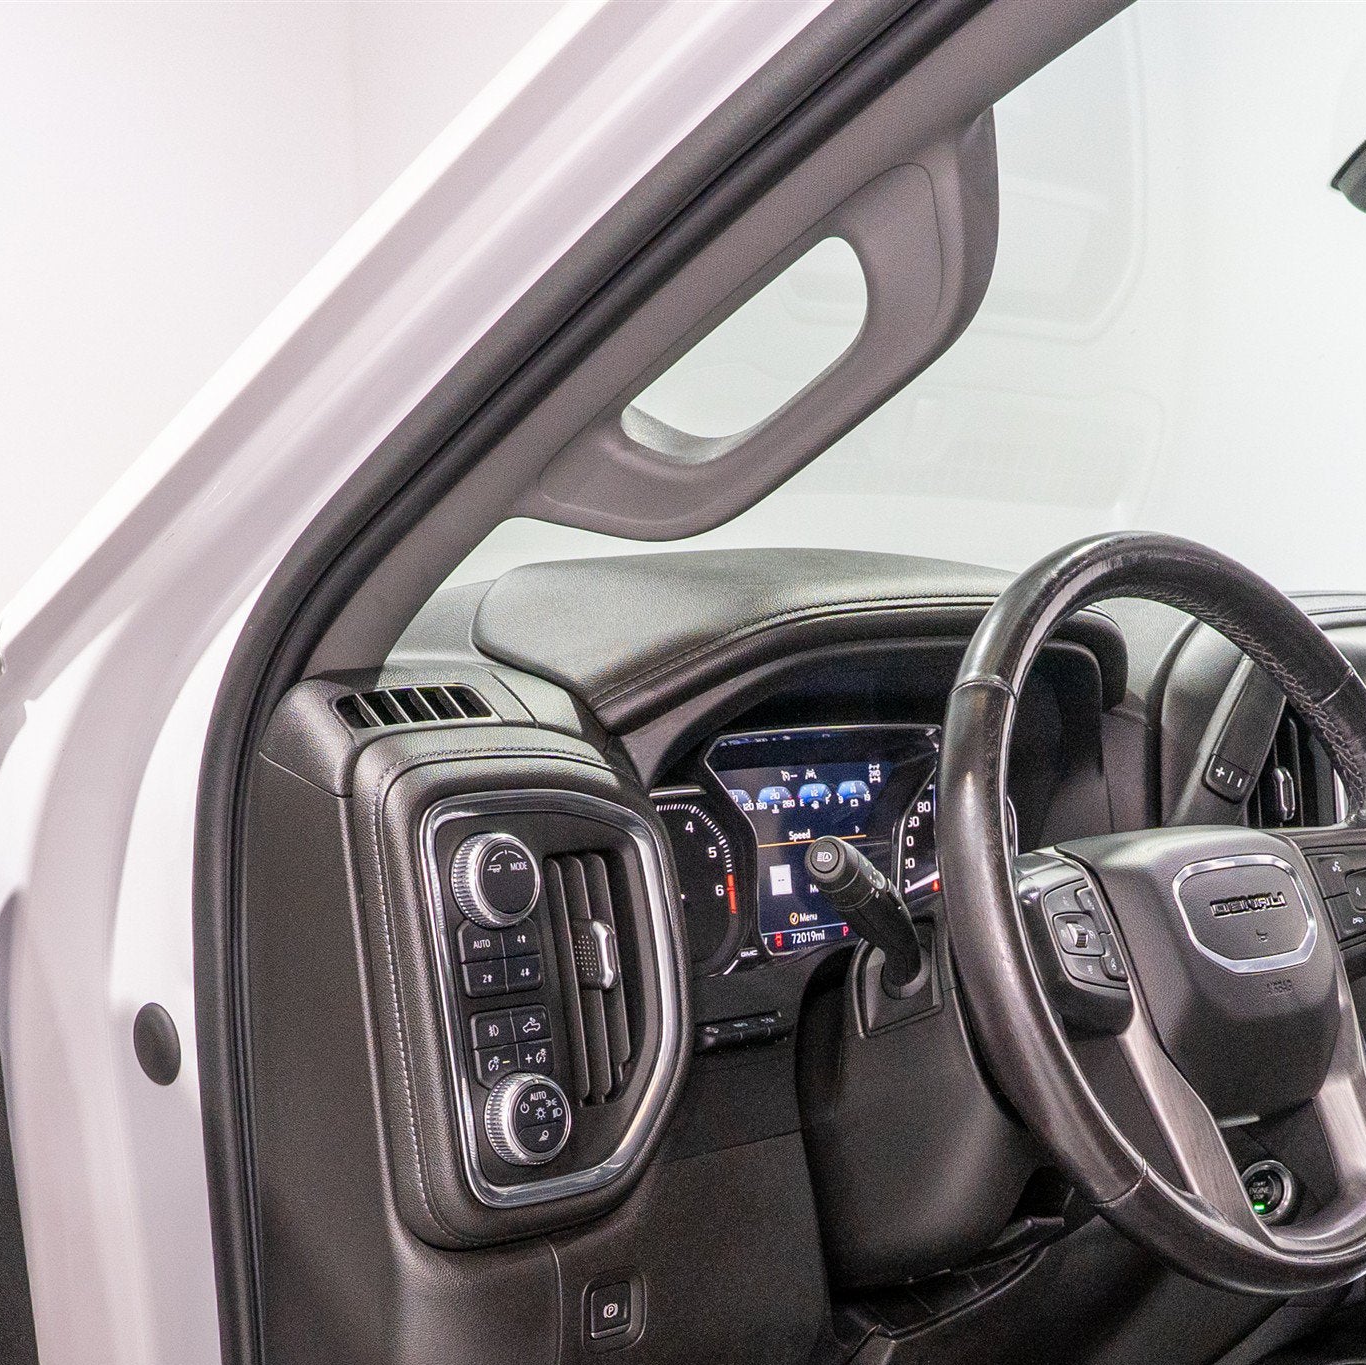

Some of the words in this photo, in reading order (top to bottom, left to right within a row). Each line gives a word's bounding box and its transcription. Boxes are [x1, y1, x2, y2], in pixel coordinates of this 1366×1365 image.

[799, 798, 805, 807] E
[917, 801, 931, 812] 80
[685, 821, 694, 833] 4
[788, 828, 811, 841] Speed
[708, 846, 717, 858] 5
[510, 861, 528, 872] MODE
[715, 884, 724, 896] 6
[1209, 891, 1288, 918] DENALI
[799, 912, 818, 923] Menu
[842, 926, 849, 937] P
[473, 938, 491, 949] AUTO
[740, 949, 758, 958] GMC
[530, 1090, 547, 1101] AUTO
